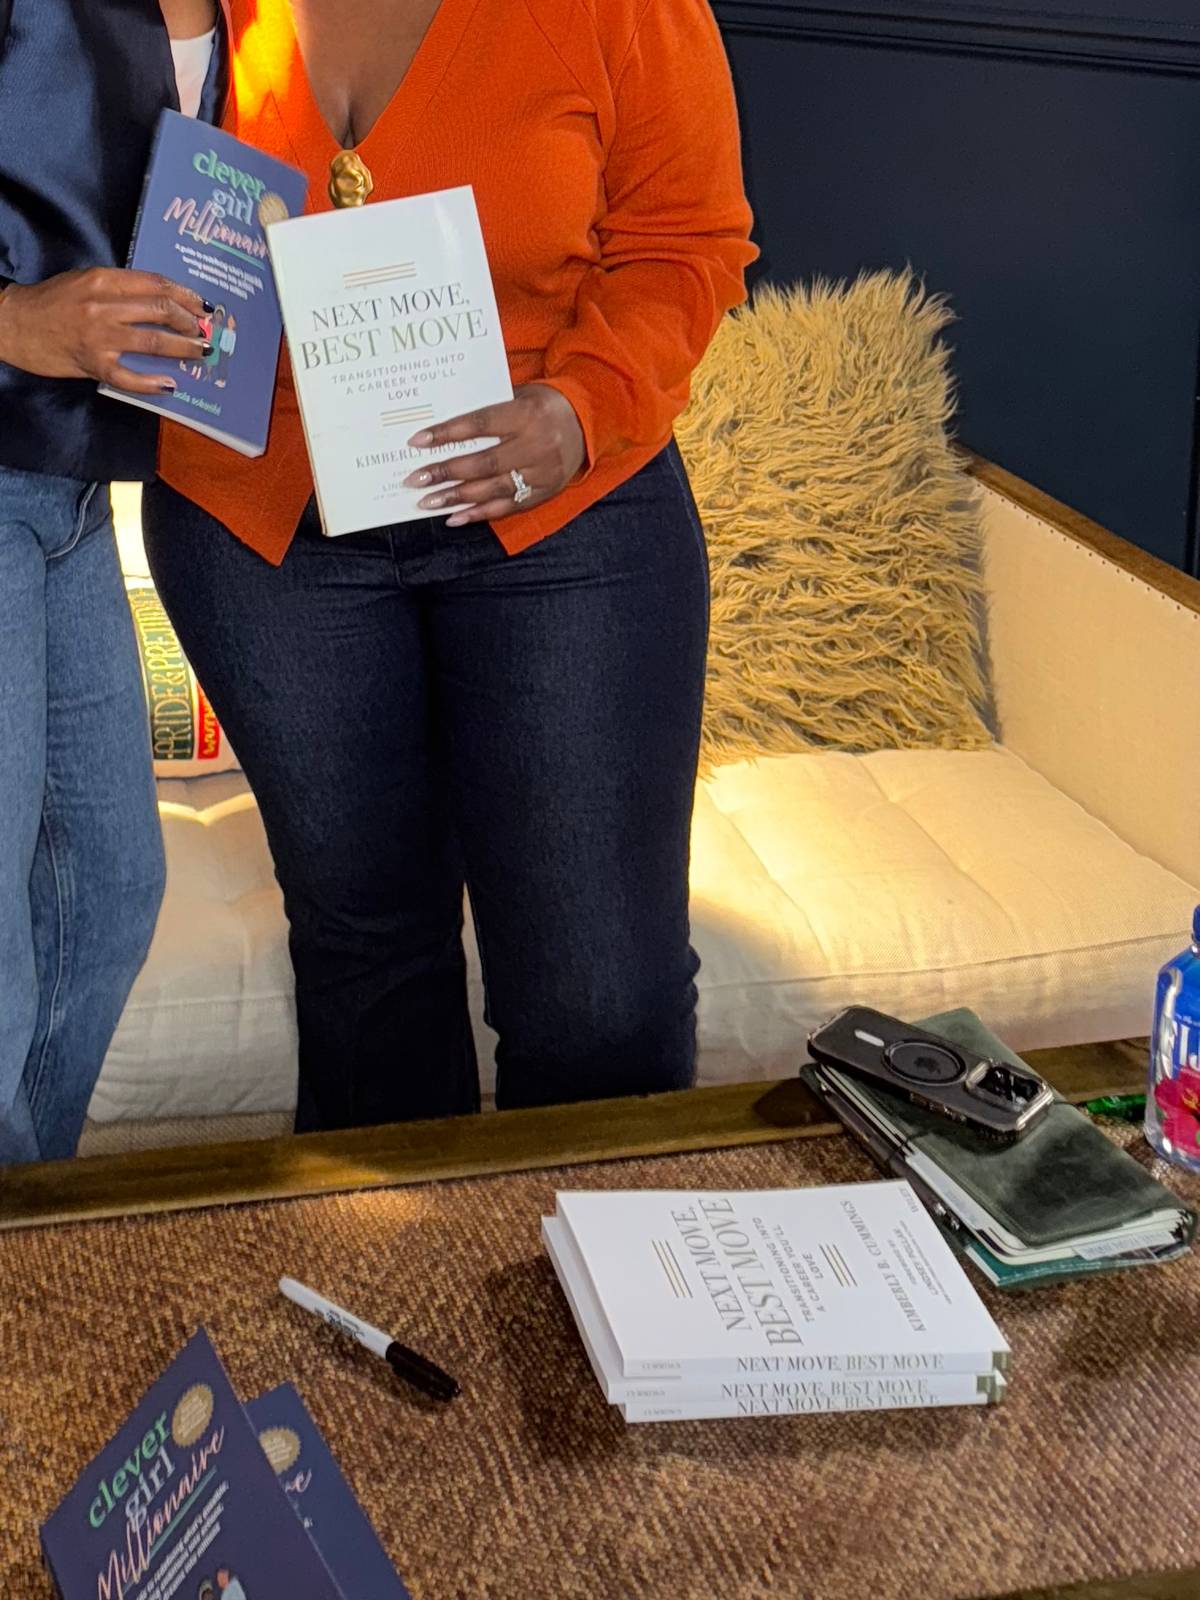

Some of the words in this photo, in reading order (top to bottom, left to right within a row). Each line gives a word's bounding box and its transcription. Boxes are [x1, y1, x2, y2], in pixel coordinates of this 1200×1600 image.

[193, 149, 266, 200] clever
[212, 188, 255, 226] girl
[312, 297, 382, 332] NEXT
[300, 327, 381, 370] BEST
[390, 308, 488, 353] MOVE
[332, 358, 431, 385] TRANSITIONING
[435, 352, 465, 366] INTO
[346, 385, 354, 395] A
[358, 376, 407, 393] CAREER
[412, 368, 457, 383] YOU'LL
[388, 387, 420, 401] LOVE
[355, 445, 422, 469] KIMBERLY
[152, 670, 187, 687] &
[151, 685, 191, 759] PRIDE
[698, 1198, 765, 1270] MOVE
[752, 1216, 772, 1242] INTO
[840, 1200, 882, 1257] CUMMINGS
[766, 1243, 815, 1323] TRANSITIONING
[792, 1262, 820, 1301] CAREER
[802, 1253, 824, 1280] LOVE
[699, 1271, 752, 1331] NEXT
[737, 1275, 804, 1346] BEST
[883, 1273, 927, 1332] KIMBERLY
[736, 1356, 784, 1372] NEXT
[845, 1354, 889, 1371] BEST
[893, 1353, 945, 1370] MOVE
[721, 1383, 768, 1399] NEXT
[830, 1380, 874, 1396] BEST
[878, 1379, 929, 1396] MOVE
[89, 1410, 171, 1528] clever
[125, 1445, 176, 1533] girl
[98, 1424, 225, 1600] Millionaire
